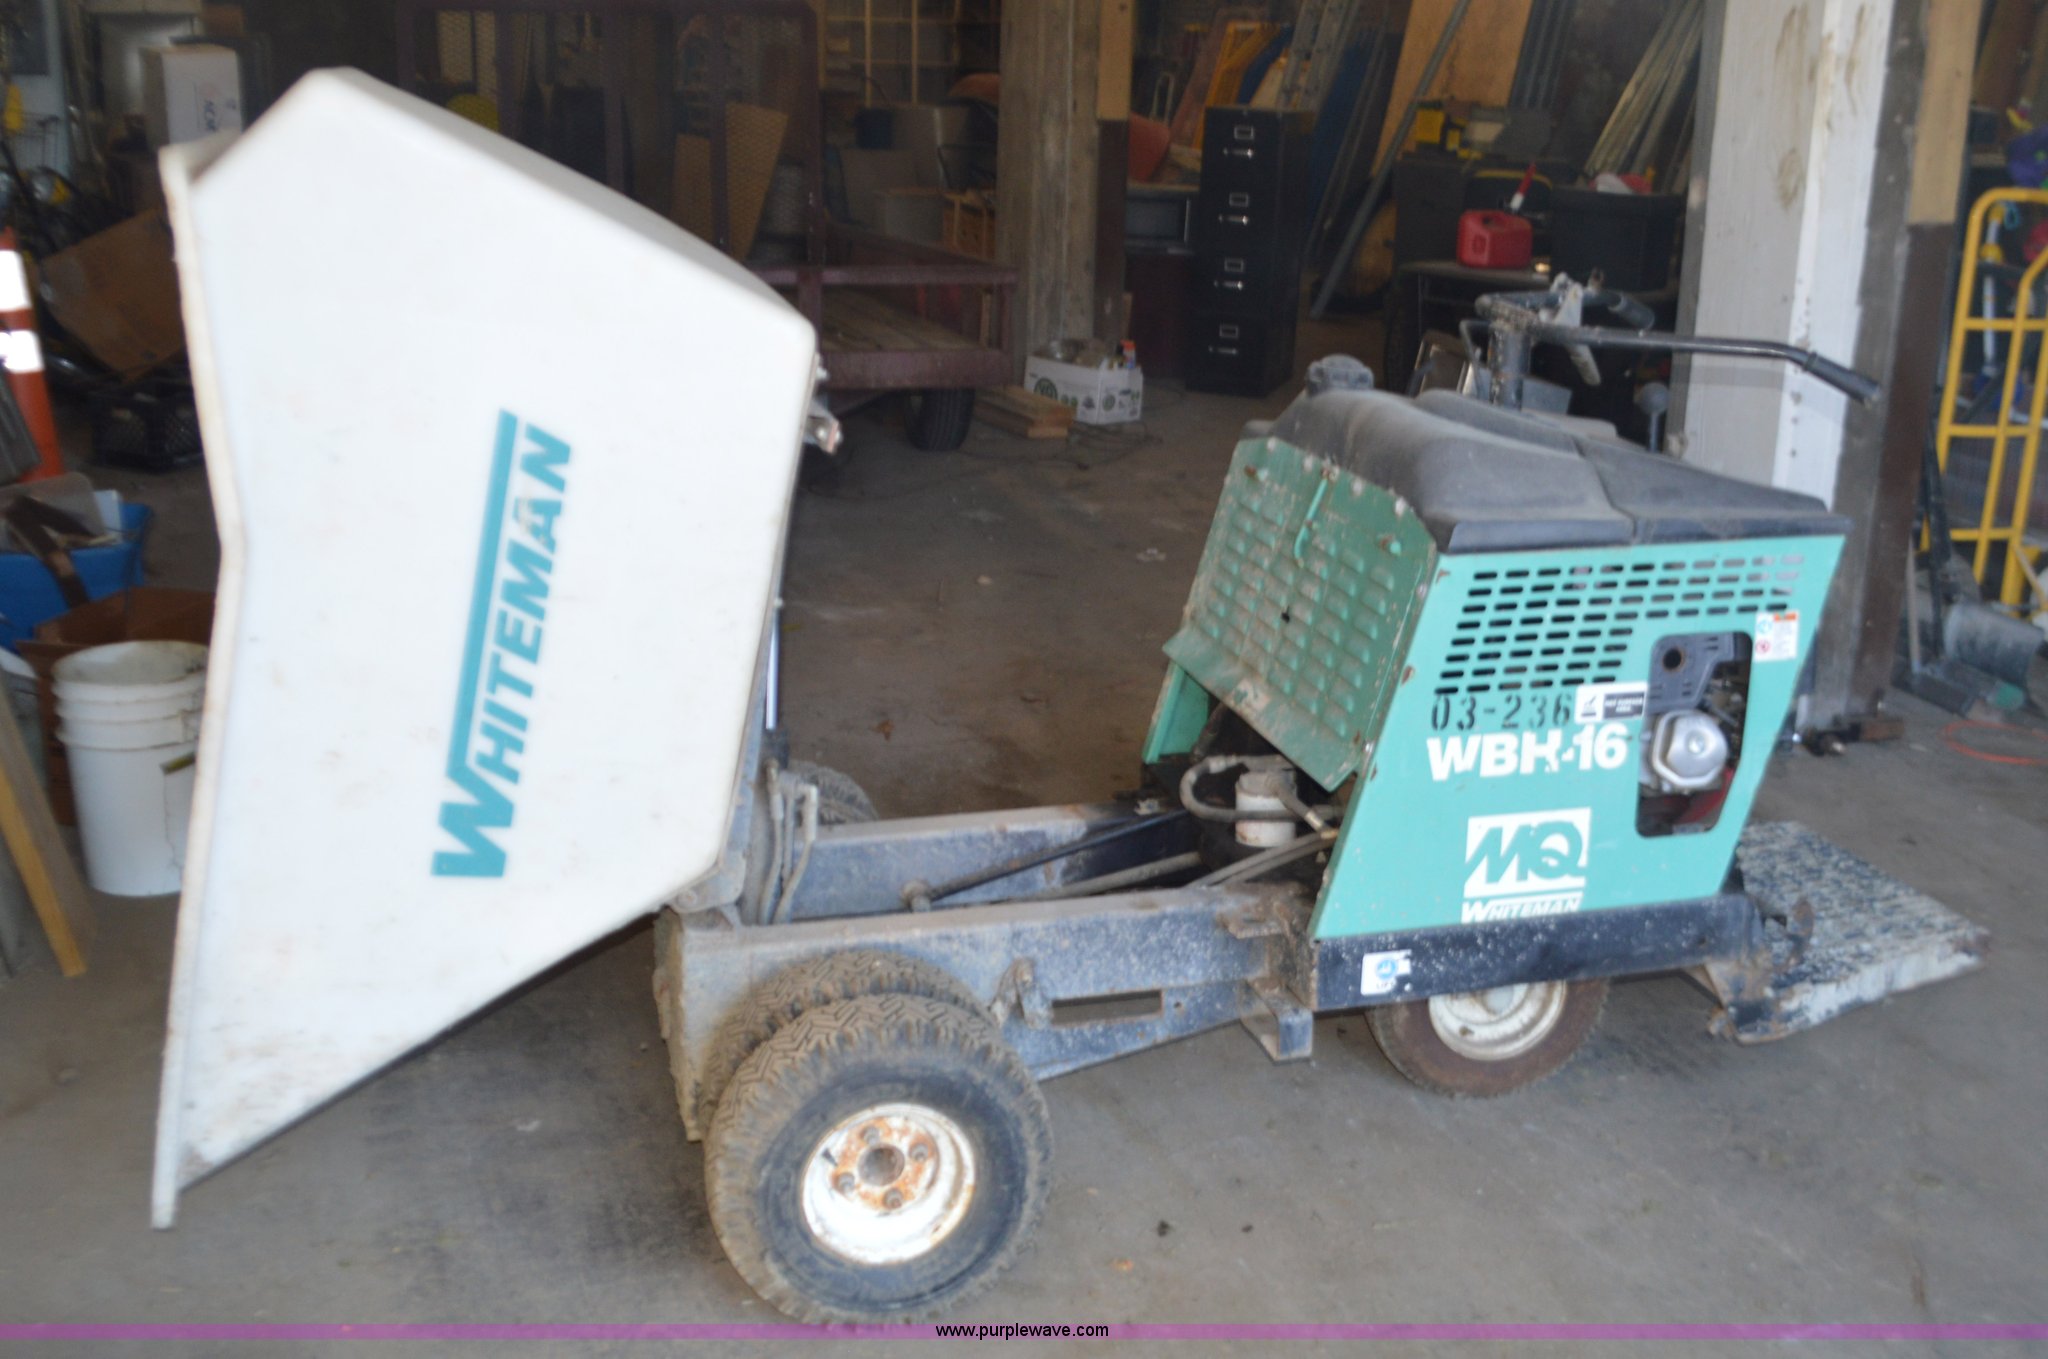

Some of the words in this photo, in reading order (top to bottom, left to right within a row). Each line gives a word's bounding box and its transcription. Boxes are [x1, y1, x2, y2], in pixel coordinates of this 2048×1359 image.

[431, 408, 571, 877] WHITEMAN
[1431, 692, 1573, 731] 03-236
[1426, 722, 1629, 782] WBH-16
[1464, 819, 1587, 885] MQ
[1461, 890, 1584, 925] WHITEMAN
